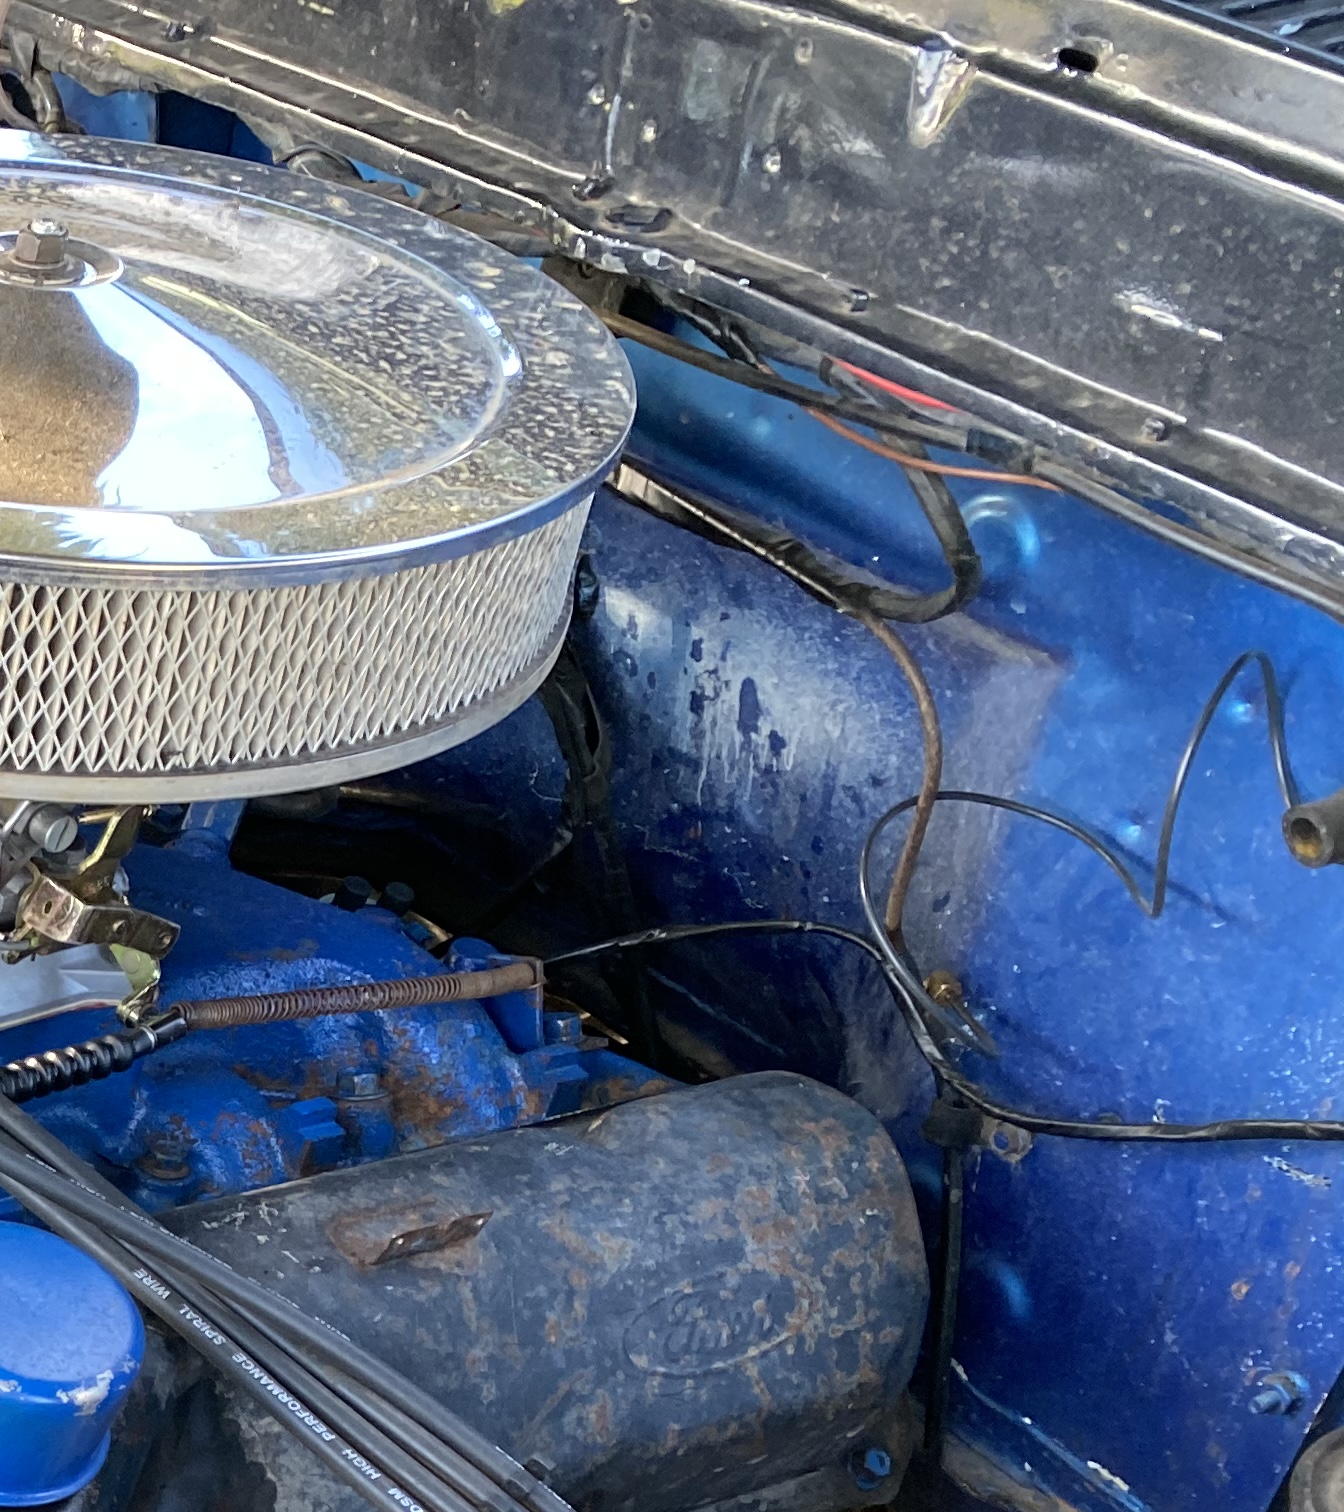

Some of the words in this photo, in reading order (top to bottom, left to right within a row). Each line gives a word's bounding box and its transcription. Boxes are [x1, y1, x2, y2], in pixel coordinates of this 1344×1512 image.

[133, 1267, 171, 1300] WIRE
[179, 1303, 227, 1346] SPIRAL
[232, 1352, 336, 1443] PERFORMANCE
[341, 1448, 382, 1480] HIGH
